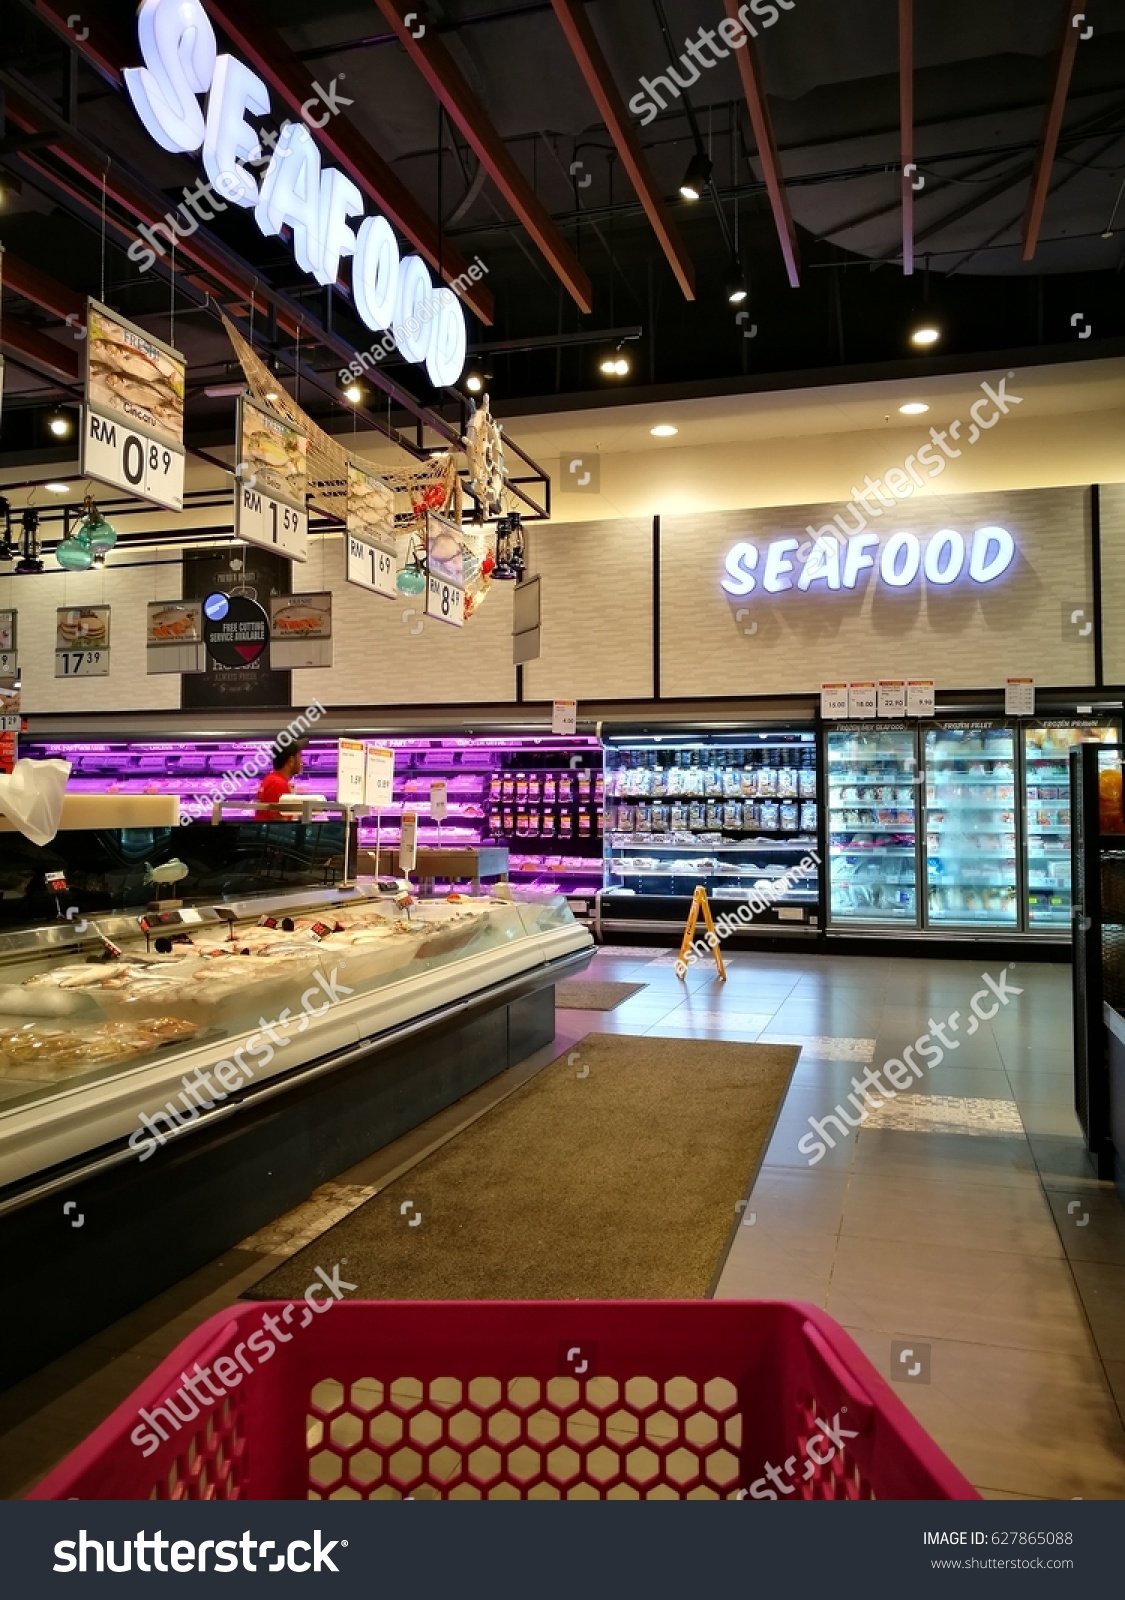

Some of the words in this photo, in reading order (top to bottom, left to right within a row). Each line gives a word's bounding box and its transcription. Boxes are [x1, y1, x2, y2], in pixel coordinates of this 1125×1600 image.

[121, 0, 467, 388] SEAFOOD
[123, 402, 157, 427] Cincaru
[89, 416, 117, 448] RM
[244, 490, 262, 513] RM
[350, 539, 364, 560] RM
[721, 526, 1016, 596] SEAFOOD
[210, 632, 234, 642] SERVICE
[235, 631, 264, 640] AVAILABLE
[223, 623, 238, 632] FREE
[239, 621, 265, 631] CUTTING
[944, 721, 969, 730] FROZEN
[970, 721, 993, 730] FILLET
[1043, 719, 1069, 729] FROZEN
